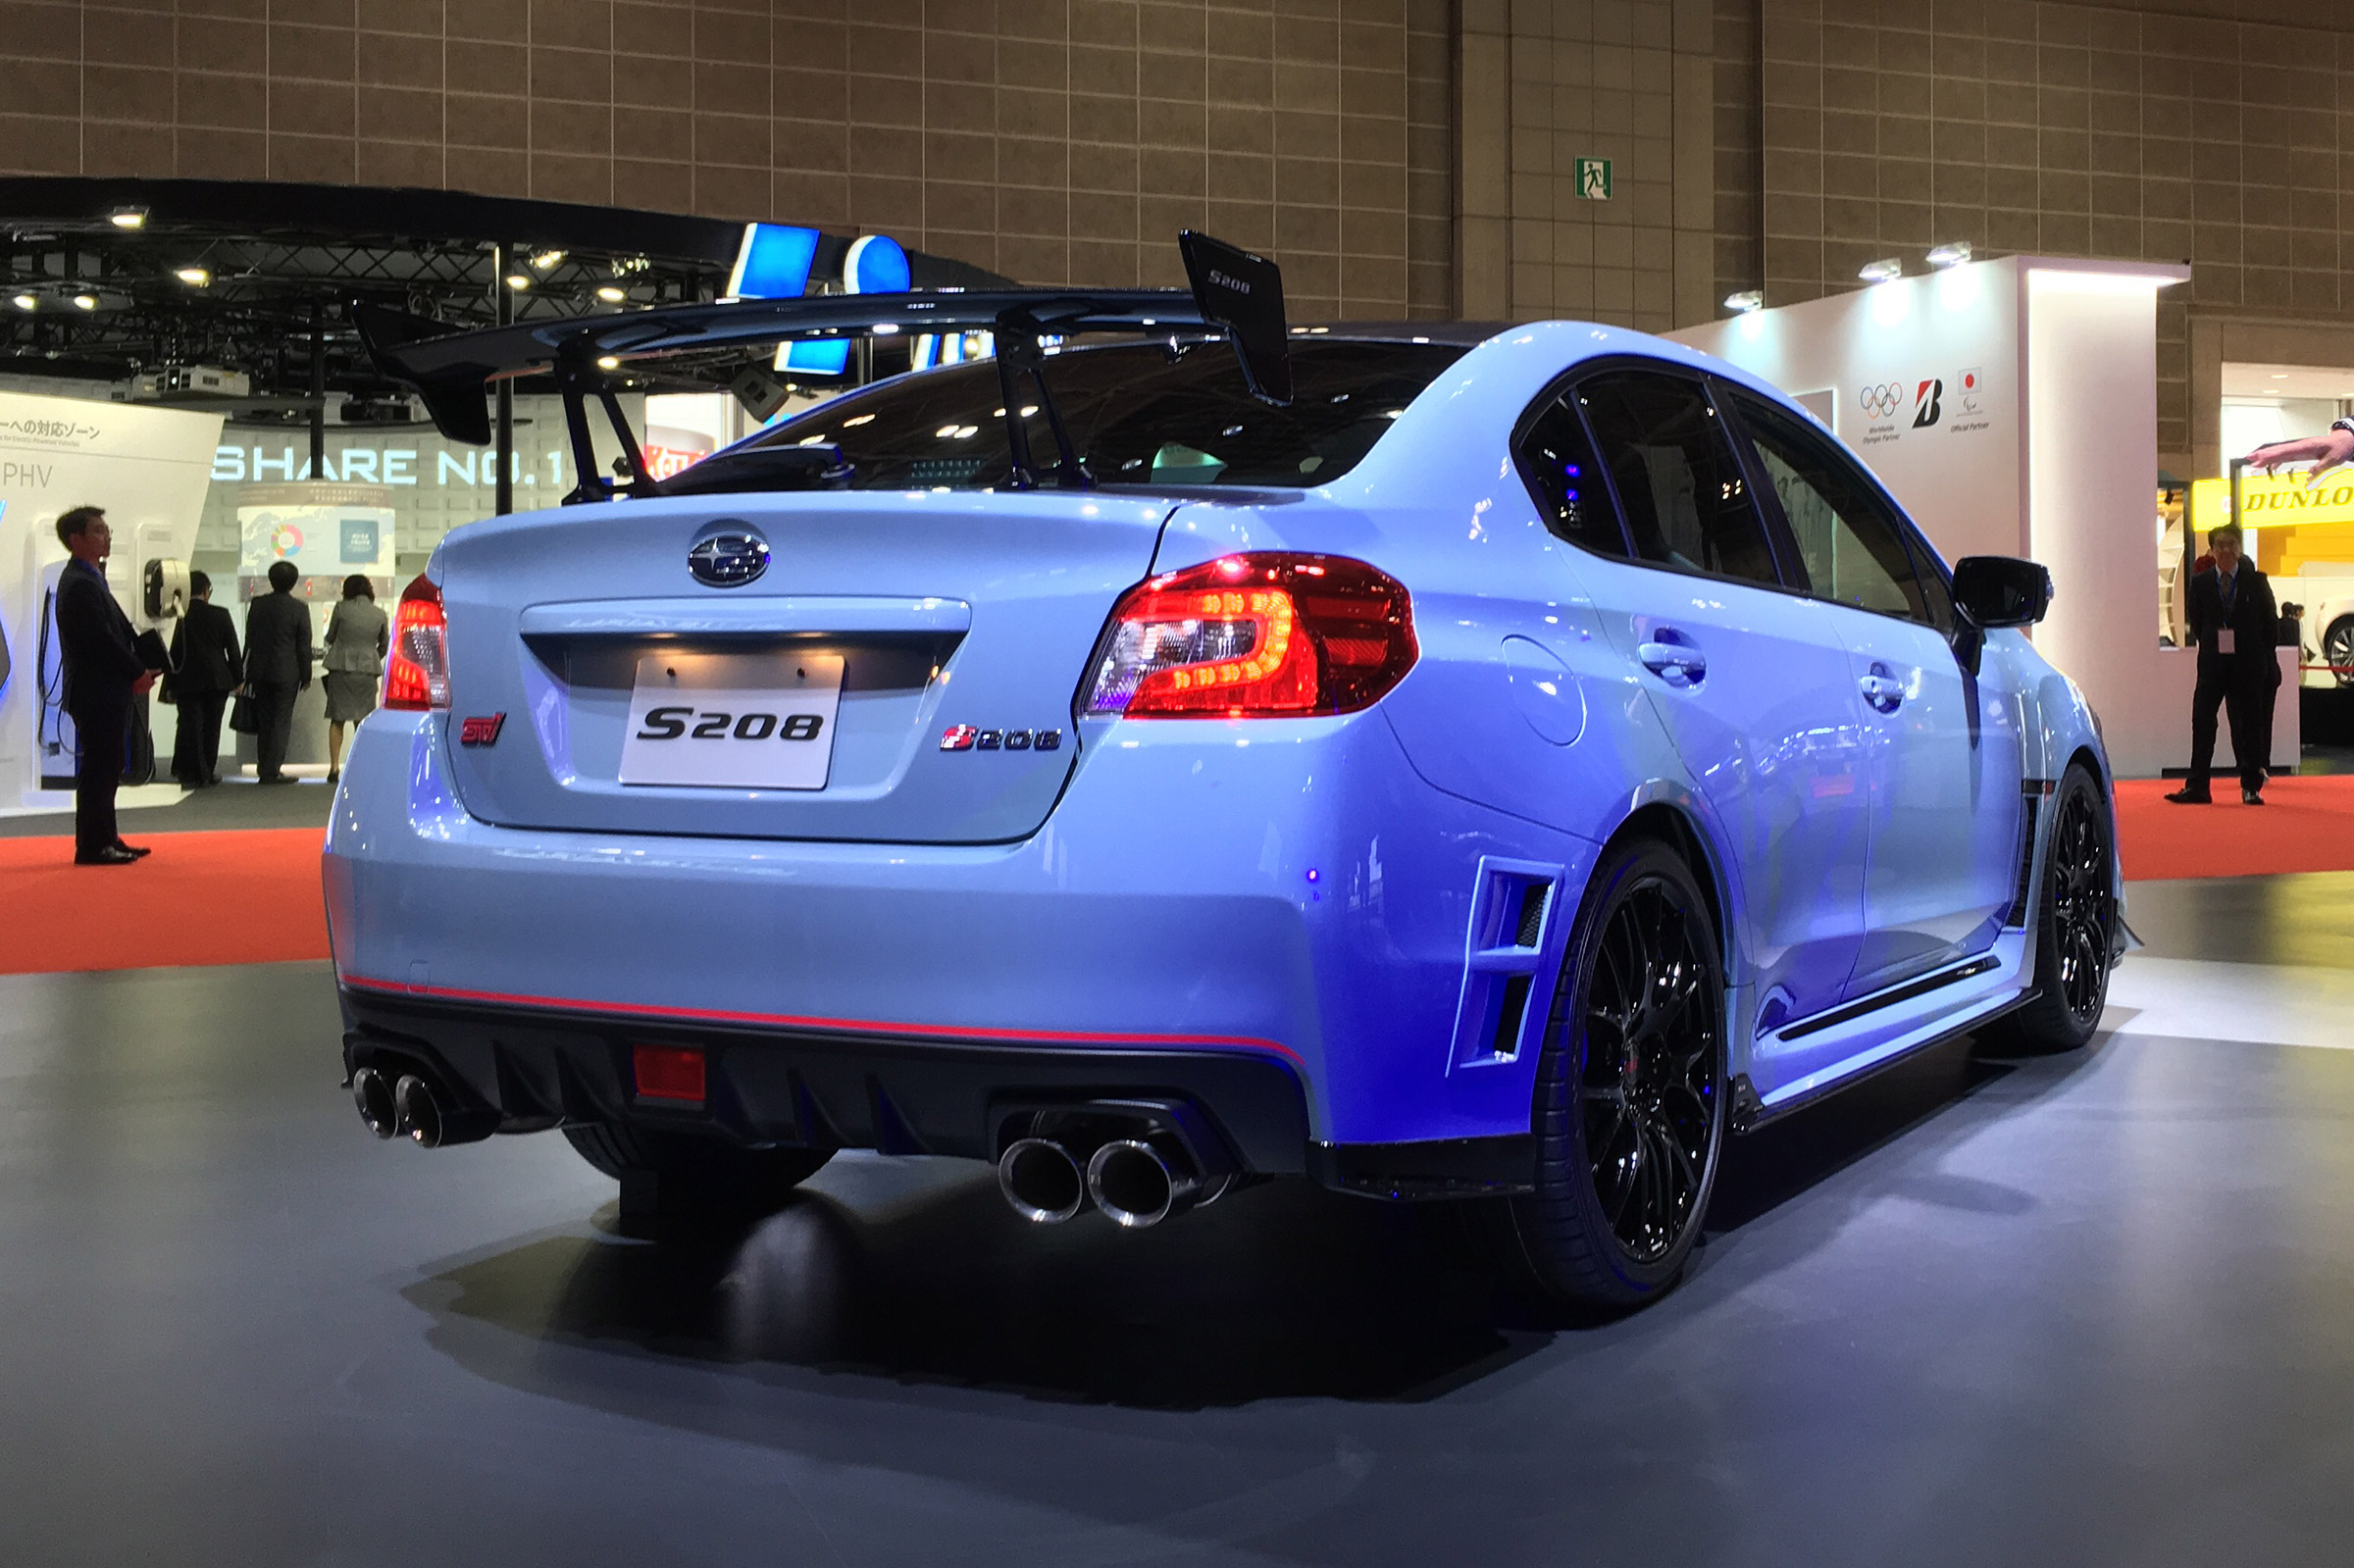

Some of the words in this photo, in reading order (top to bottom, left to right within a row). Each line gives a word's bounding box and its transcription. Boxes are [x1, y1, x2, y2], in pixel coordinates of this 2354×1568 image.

[1207, 269, 1251, 294] S208
[1862, 435, 1882, 445] Olympic
[1882, 432, 1901, 442] Partner
[1950, 424, 1969, 433] Official
[1970, 422, 1990, 430] Partner
[3, 462, 53, 488] PHV
[210, 446, 418, 484] SHARE
[636, 707, 825, 741] S208
[939, 724, 1062, 752] S208
